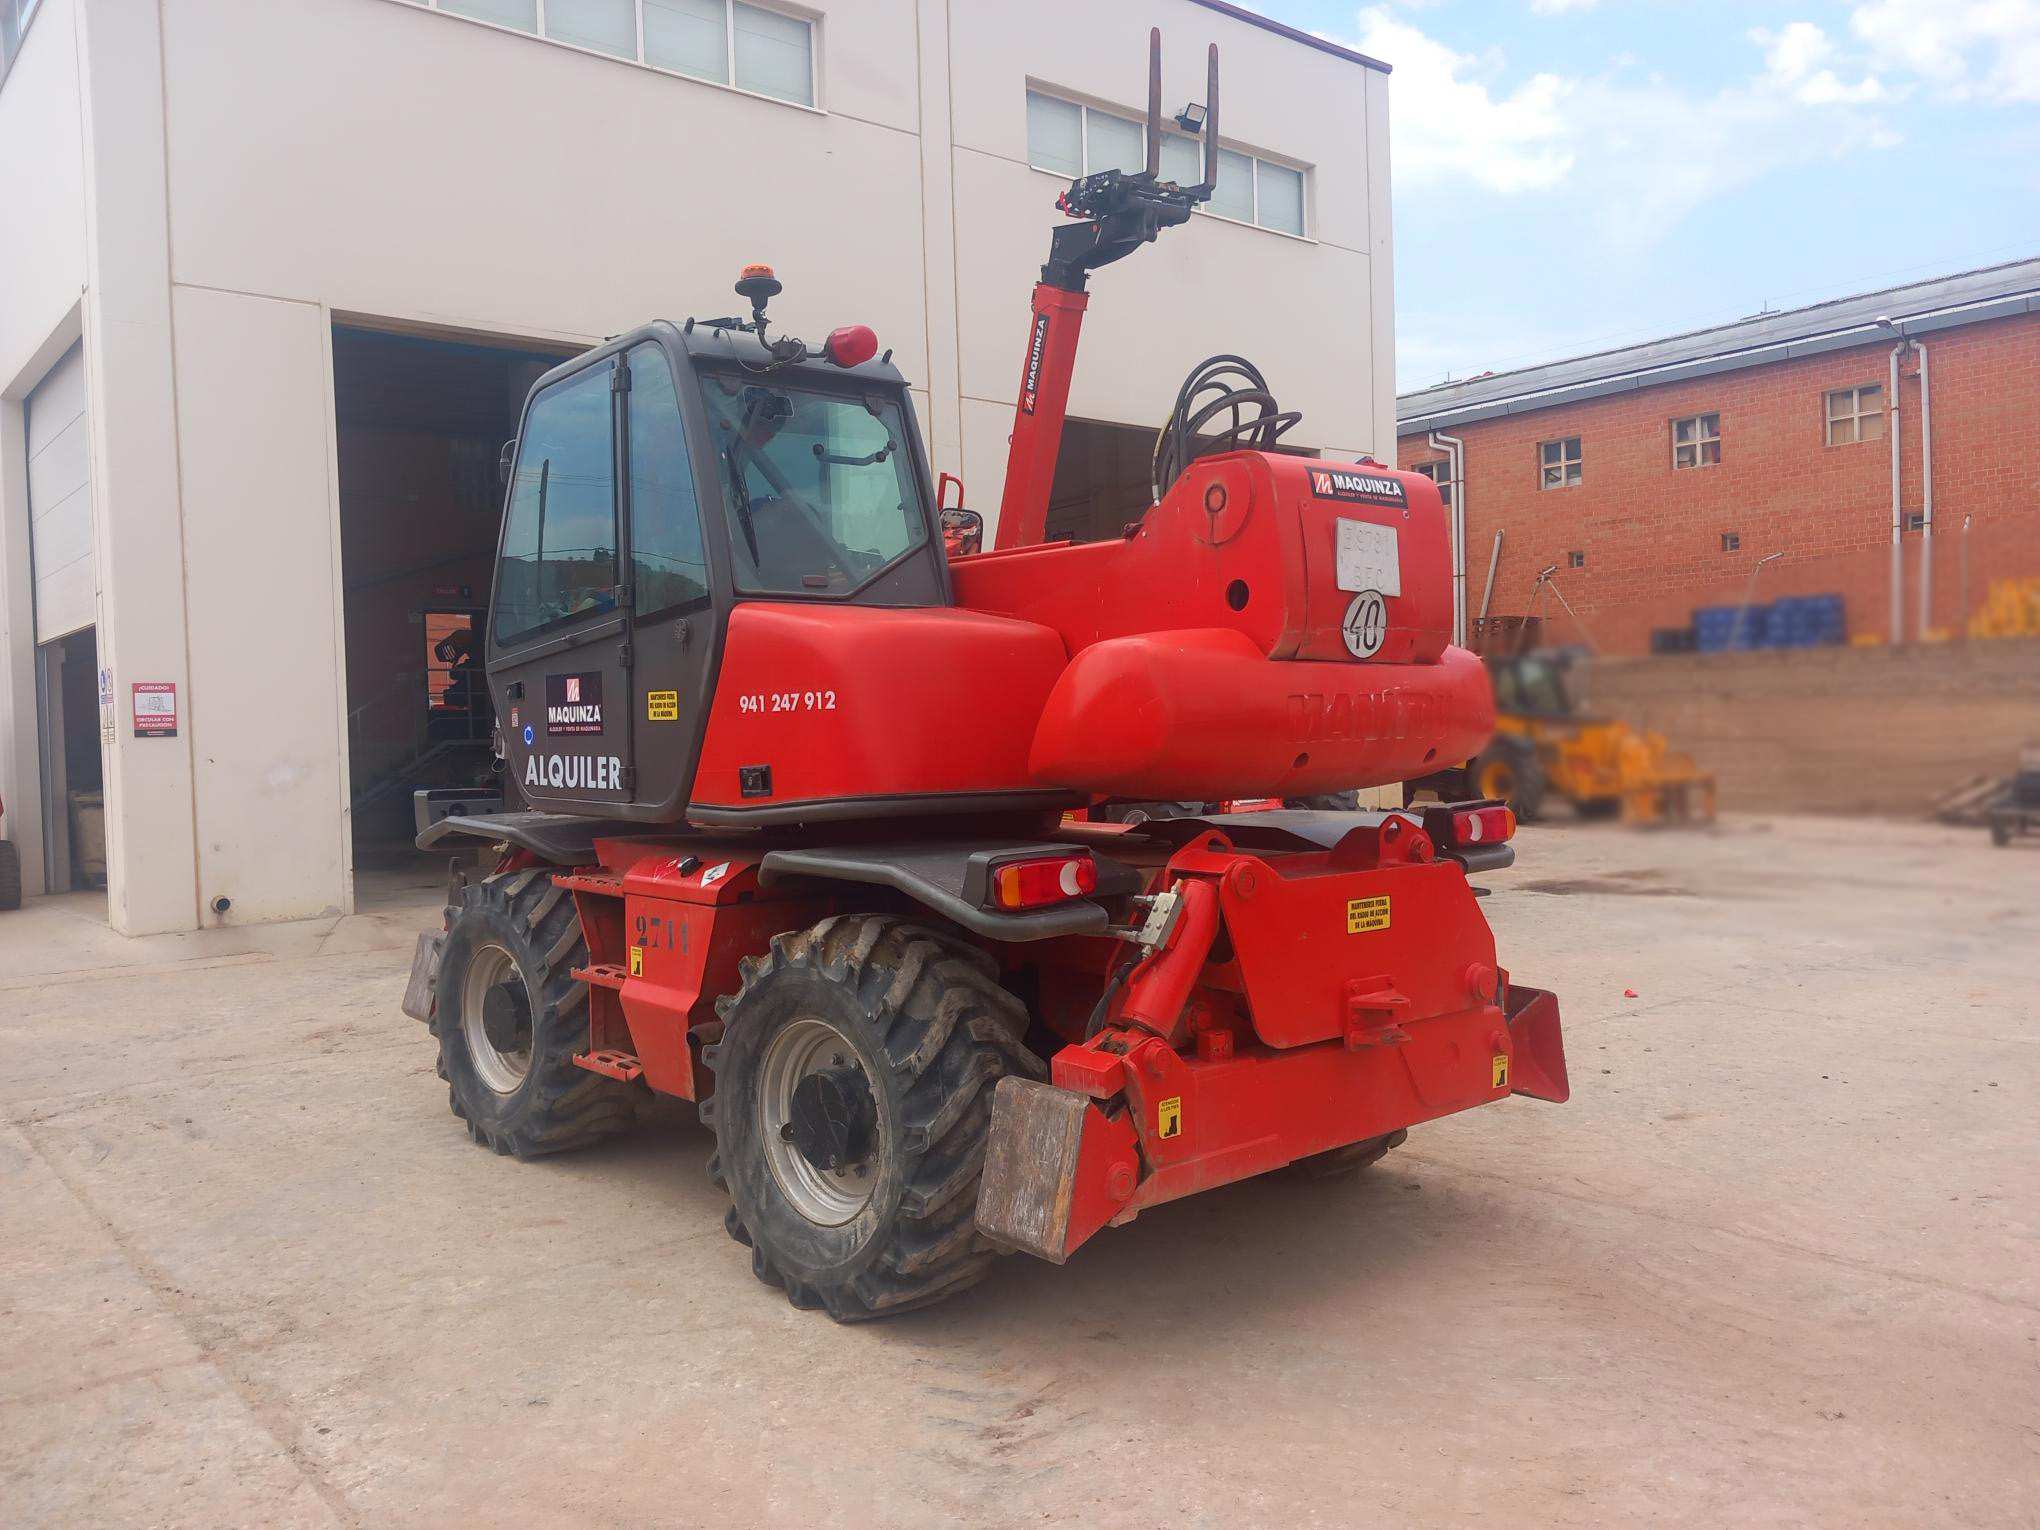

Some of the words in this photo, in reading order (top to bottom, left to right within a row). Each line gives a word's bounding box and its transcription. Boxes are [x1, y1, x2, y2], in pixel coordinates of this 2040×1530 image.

[1027, 320, 1045, 390] MAQUINZA
[1332, 474, 1402, 496] MAQUINZA
[1349, 600, 1380, 650] 40
[548, 705, 601, 724] MAQUINZA
[740, 695, 765, 713] 941
[771, 693, 800, 712] 247
[804, 690, 836, 710] 912
[525, 754, 622, 790] ALQUILER
